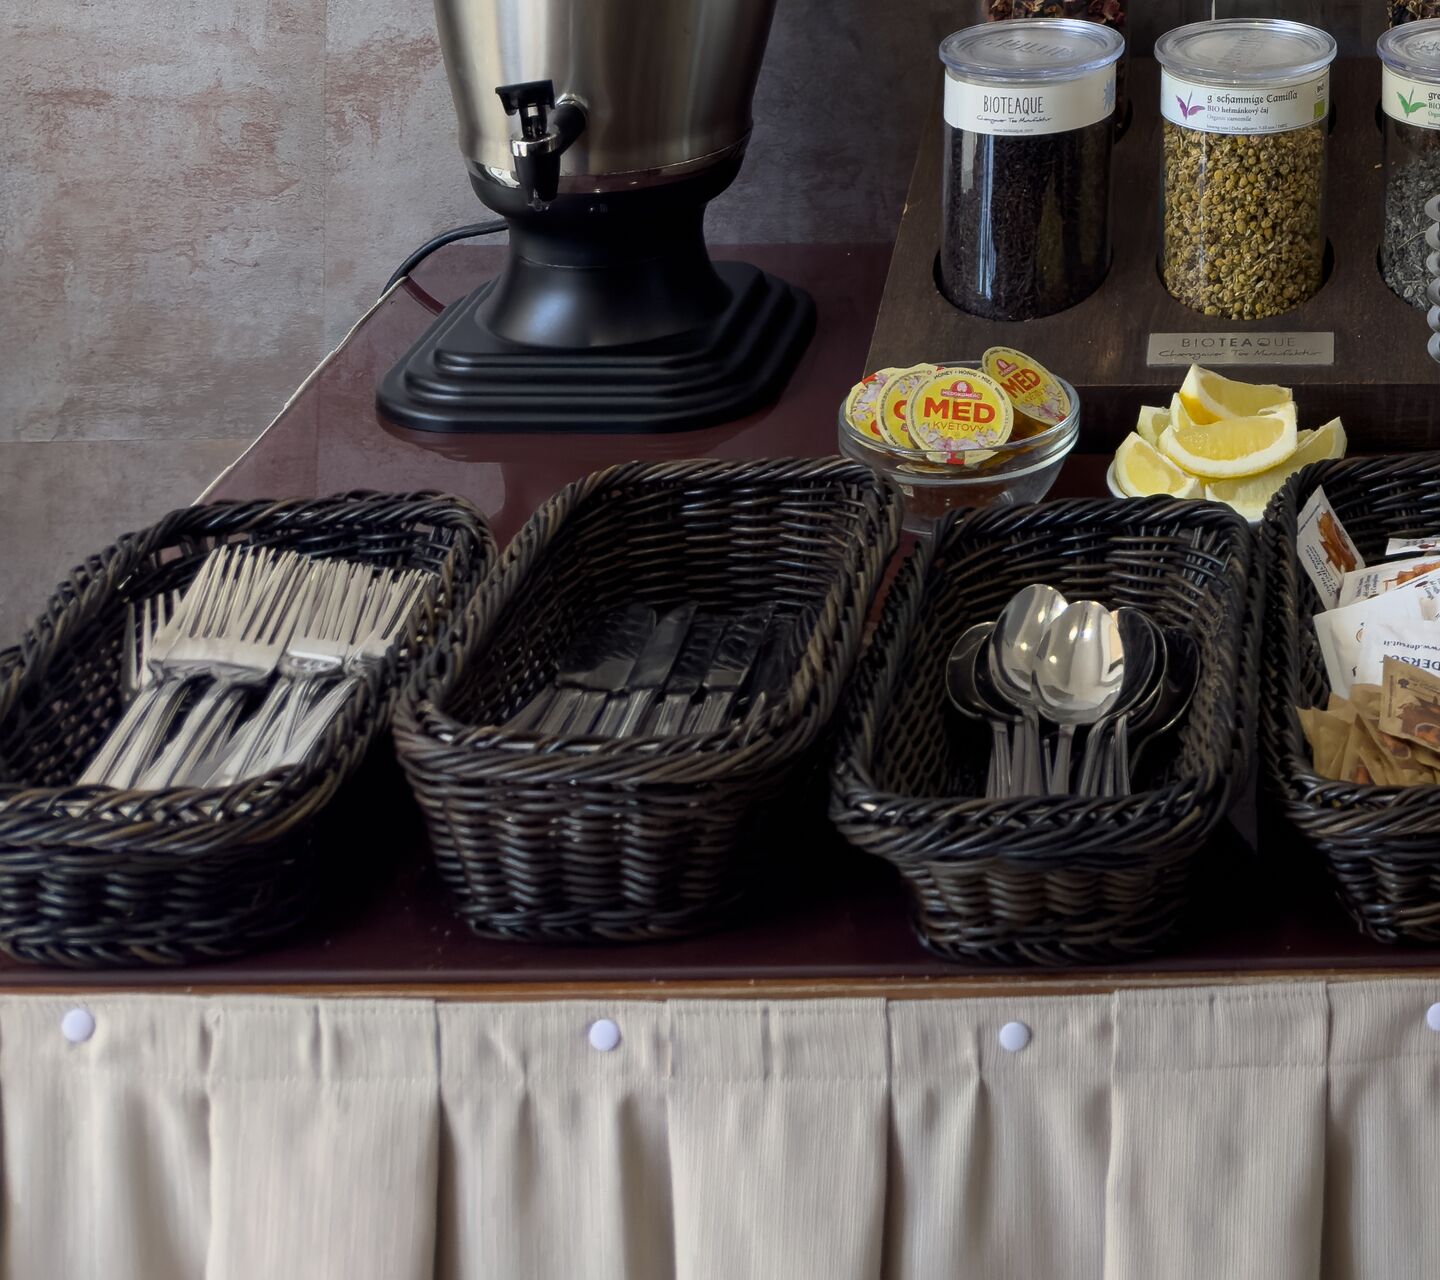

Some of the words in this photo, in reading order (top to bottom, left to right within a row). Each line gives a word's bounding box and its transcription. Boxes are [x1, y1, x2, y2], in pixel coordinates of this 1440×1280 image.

[983, 95, 1044, 114] BIOTEAQUE
[1207, 105, 1220, 113] BIO
[1181, 337, 1297, 348] BIOTEAQUE
[1000, 368, 1041, 400] MED
[923, 397, 996, 425] MED
